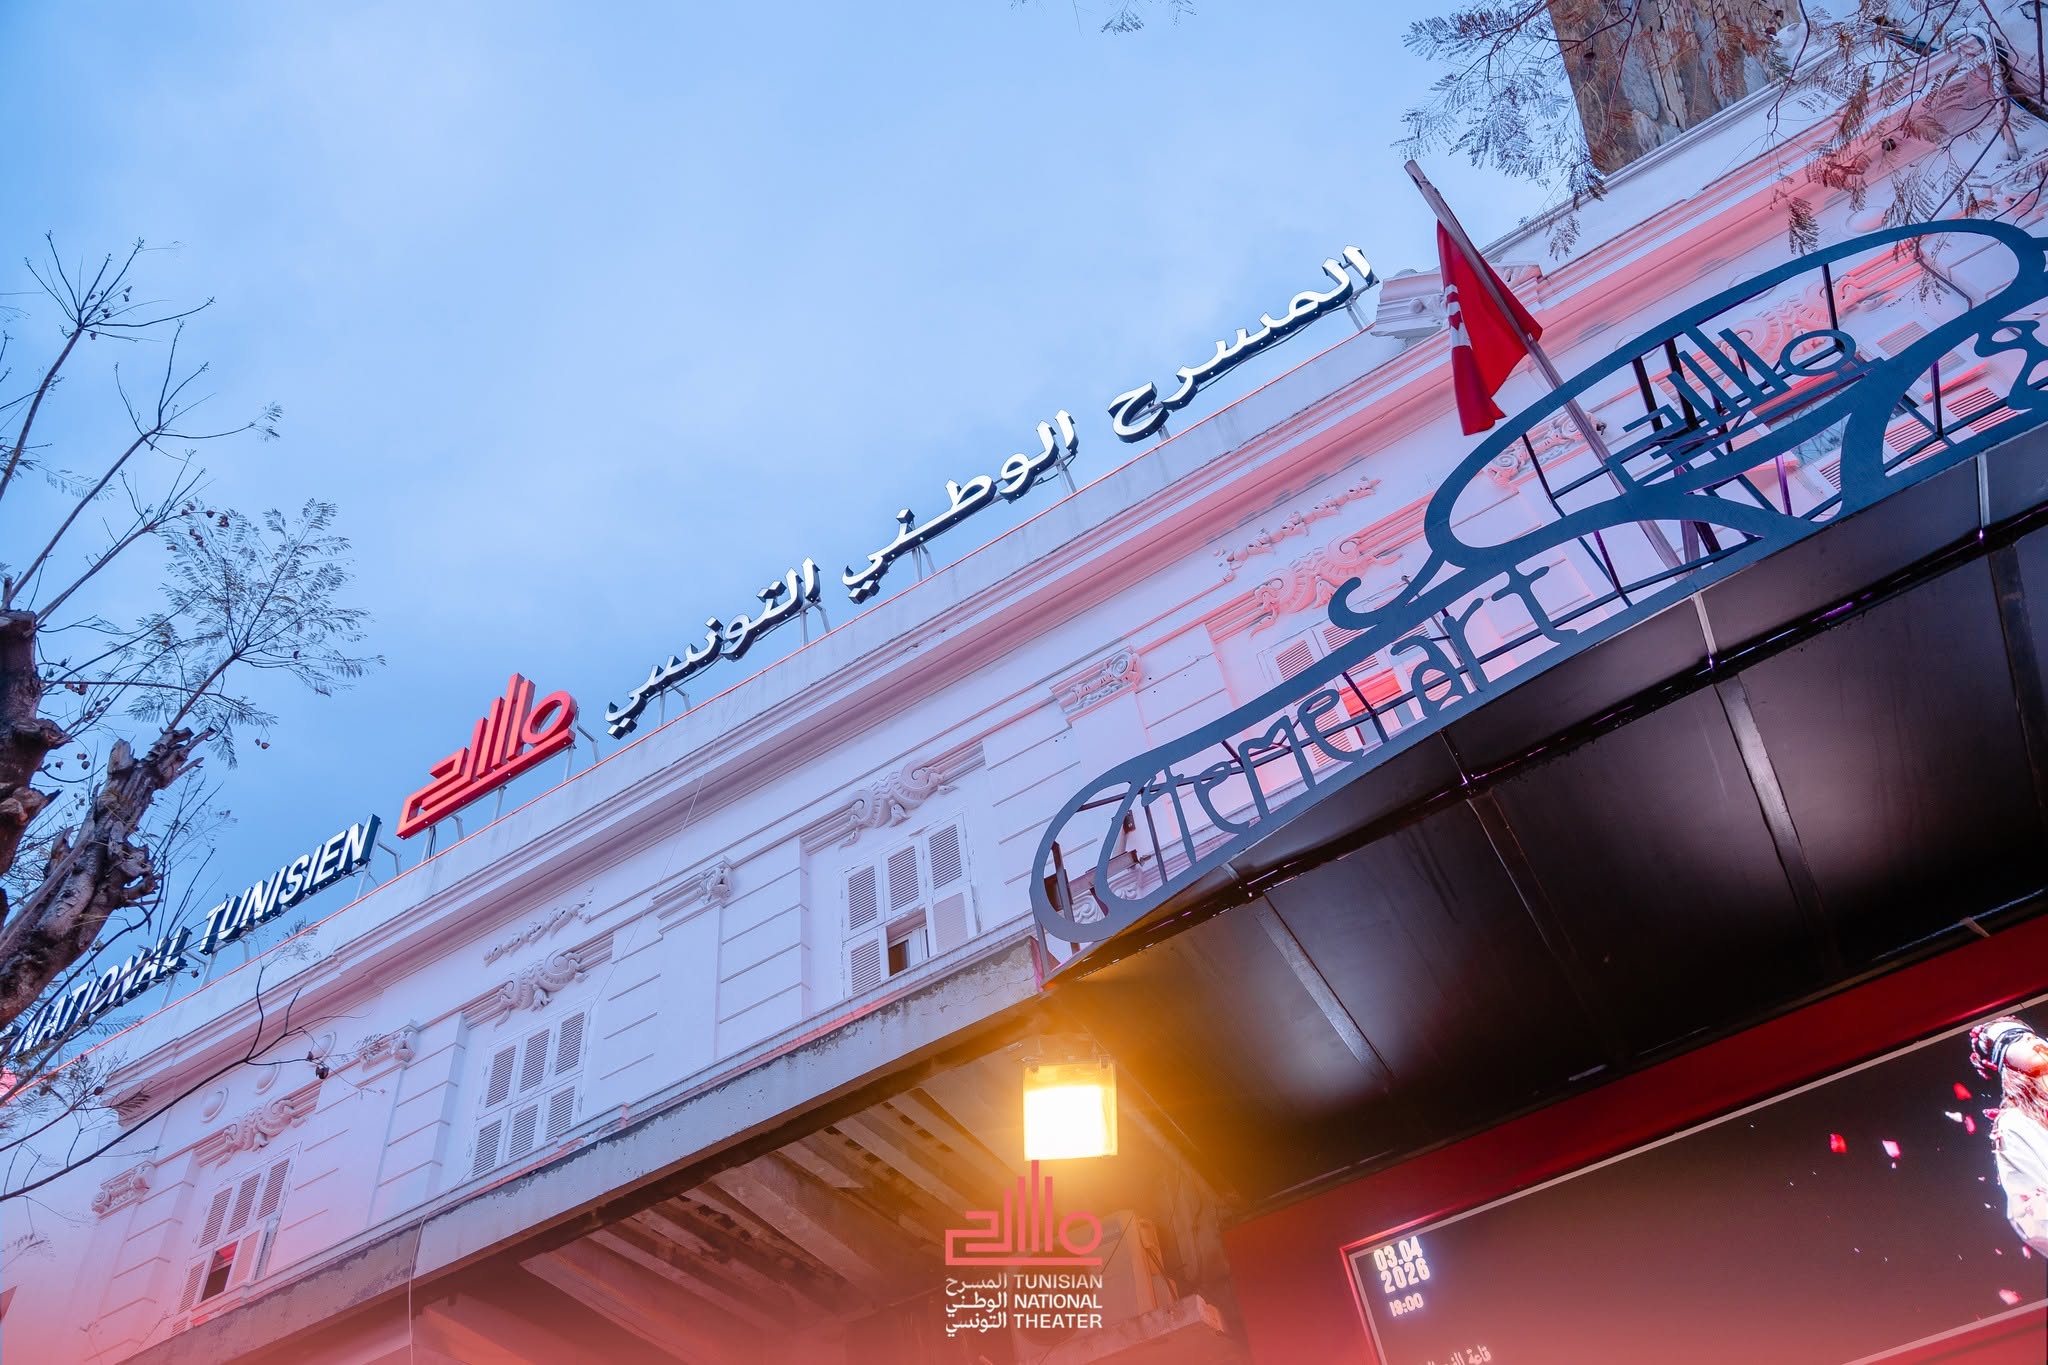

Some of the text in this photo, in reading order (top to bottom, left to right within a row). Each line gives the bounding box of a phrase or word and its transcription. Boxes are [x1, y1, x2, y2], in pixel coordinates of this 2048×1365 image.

[604, 245, 1376, 740] المسرح الوطني التونسي
[9, 813, 382, 1058] NATIONAL TUNISIEN
[1373, 1235, 1423, 1272] 03.04
[1380, 1257, 1431, 1294] 2026
